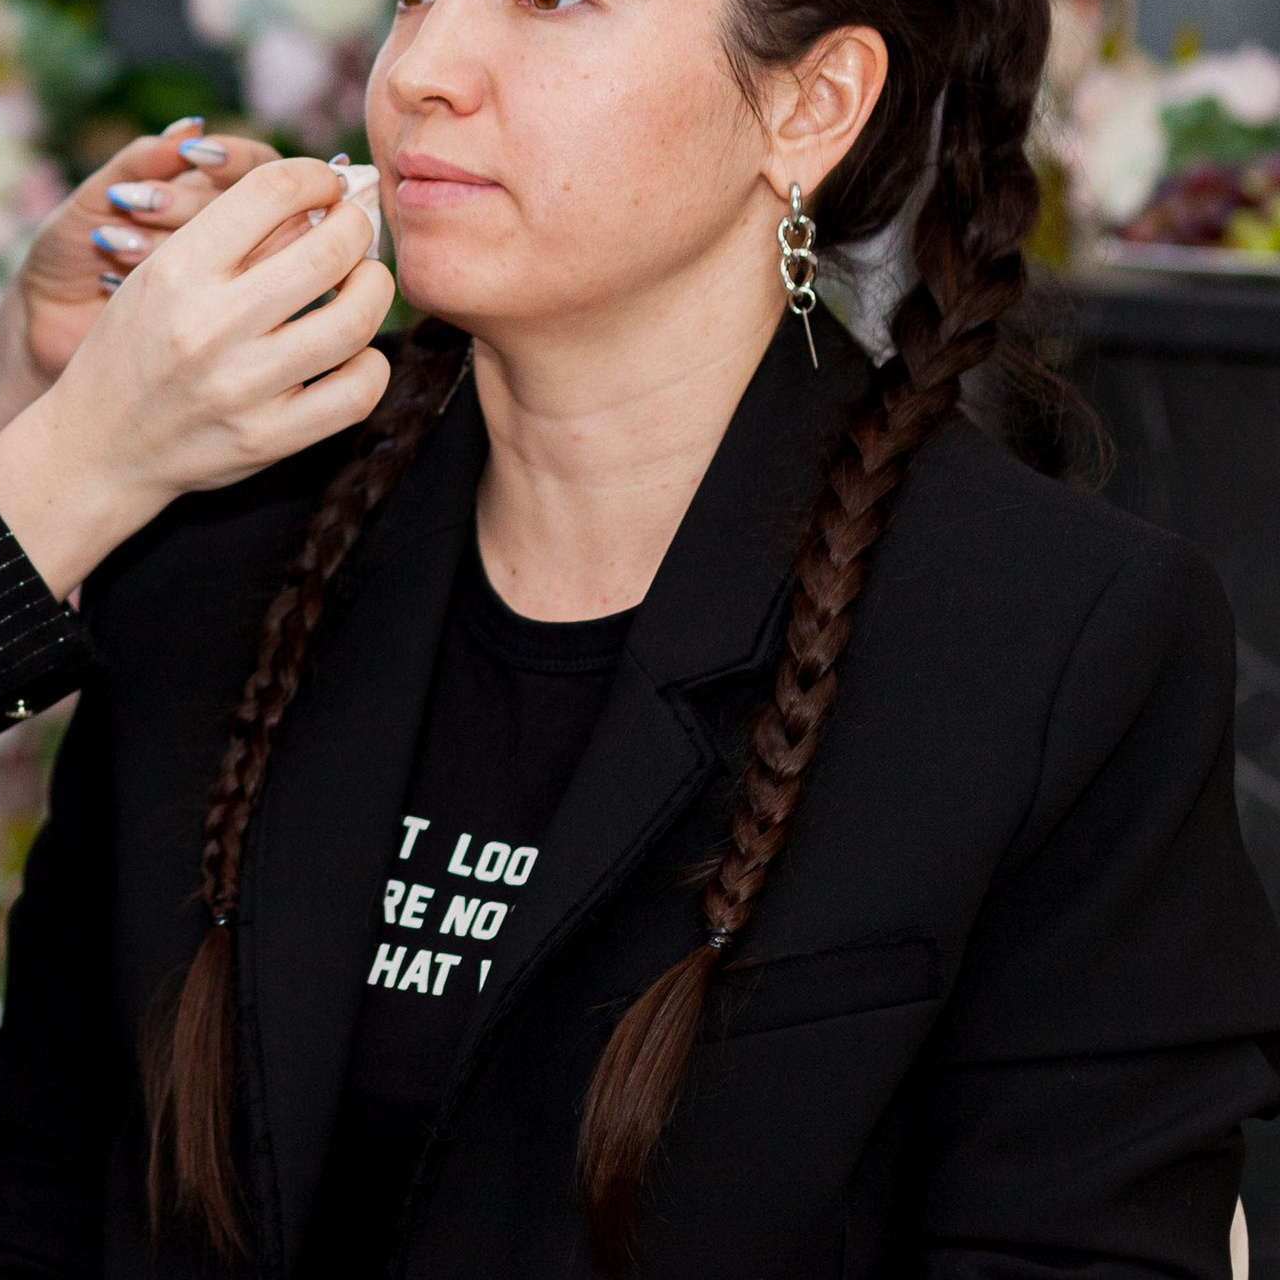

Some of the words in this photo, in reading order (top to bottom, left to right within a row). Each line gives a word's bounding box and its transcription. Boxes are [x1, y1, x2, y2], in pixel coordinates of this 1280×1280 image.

[399, 816, 430, 859] T
[447, 833, 539, 886] LOO
[383, 879, 435, 929] RE
[439, 895, 516, 940] NO
[367, 943, 462, 996] HAT
